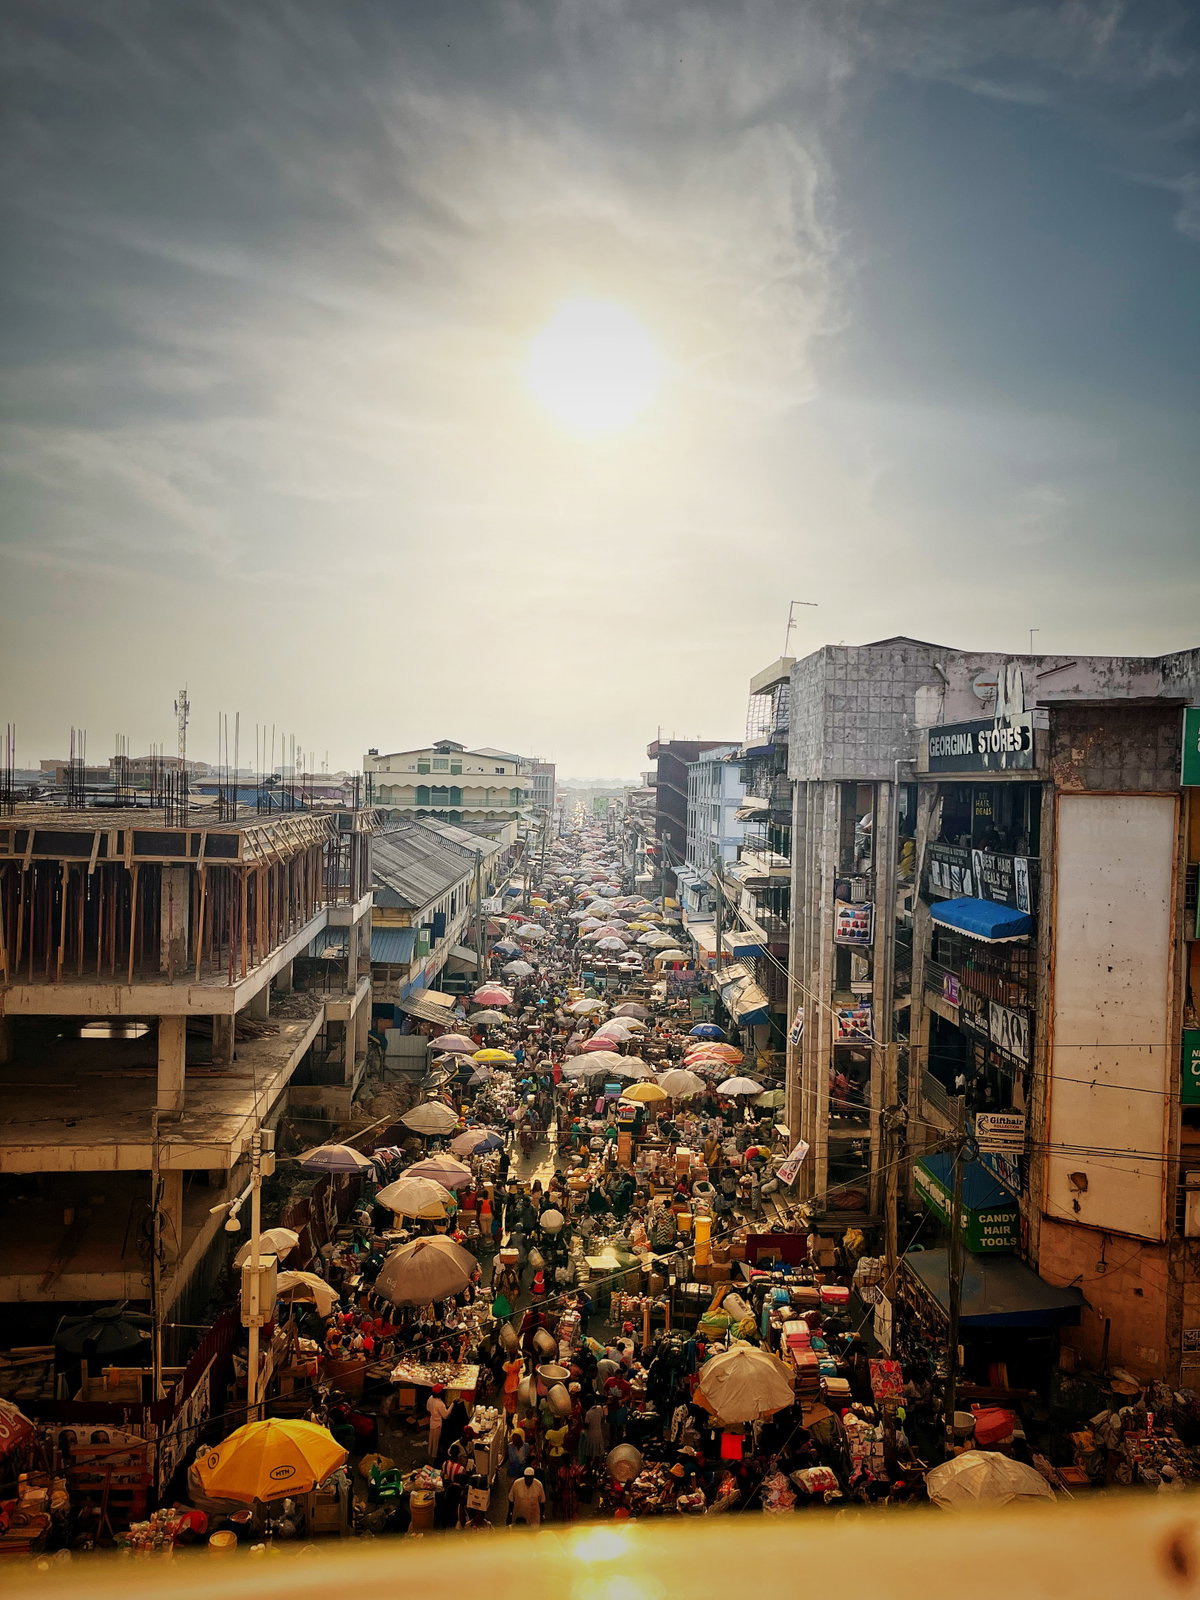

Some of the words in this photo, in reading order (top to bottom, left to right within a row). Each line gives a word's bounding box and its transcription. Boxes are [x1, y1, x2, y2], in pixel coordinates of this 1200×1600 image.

[929, 733, 973, 757] GEORGINA
[978, 726, 1021, 754] STORES
[990, 1116, 1024, 1126] Gifthair
[978, 1213, 1016, 1223] CANDY
[984, 1226, 1011, 1235] HAIR
[980, 1237, 1017, 1247] TOOLS
[275, 1468, 290, 1478] MTN
